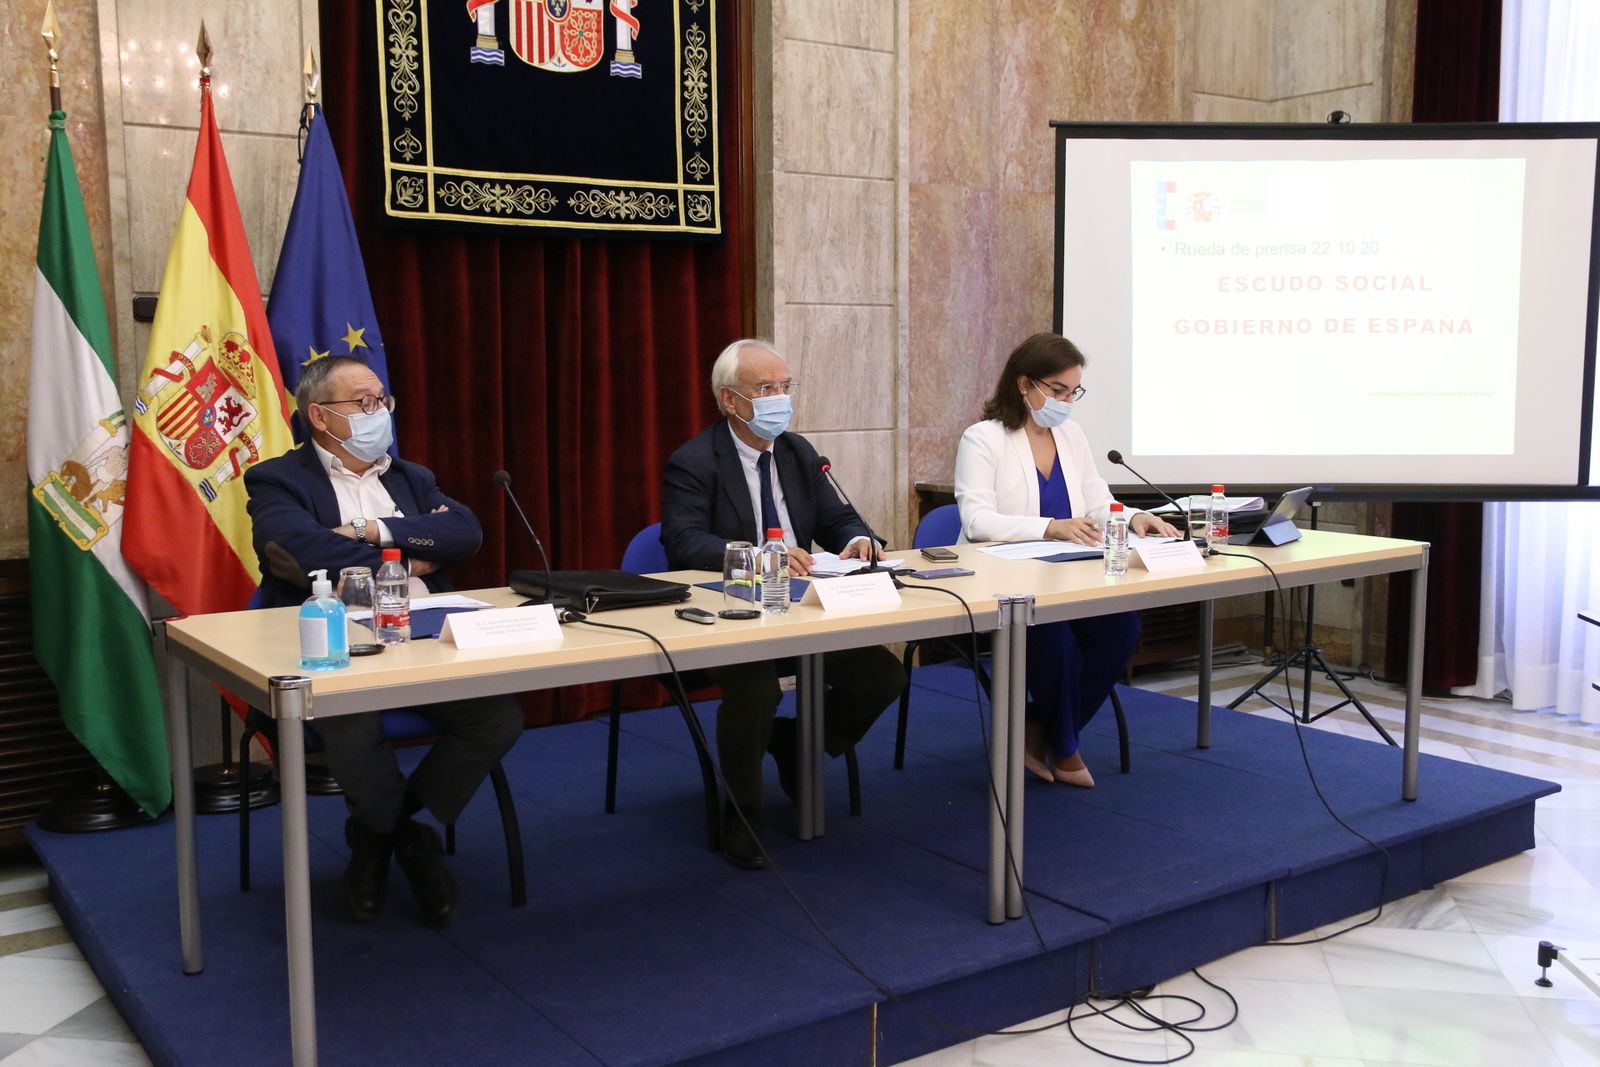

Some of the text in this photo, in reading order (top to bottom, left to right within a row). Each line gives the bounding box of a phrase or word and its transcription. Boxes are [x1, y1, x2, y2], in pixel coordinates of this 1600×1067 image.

[1175, 242, 1225, 256] Rueda
[1230, 242, 1250, 256] de
[1255, 243, 1306, 258] prensa
[1217, 274, 1433, 292] ESCUDO SOCIAL
[1175, 314, 1473, 335] GOBIERNO DE ESPAÑA
